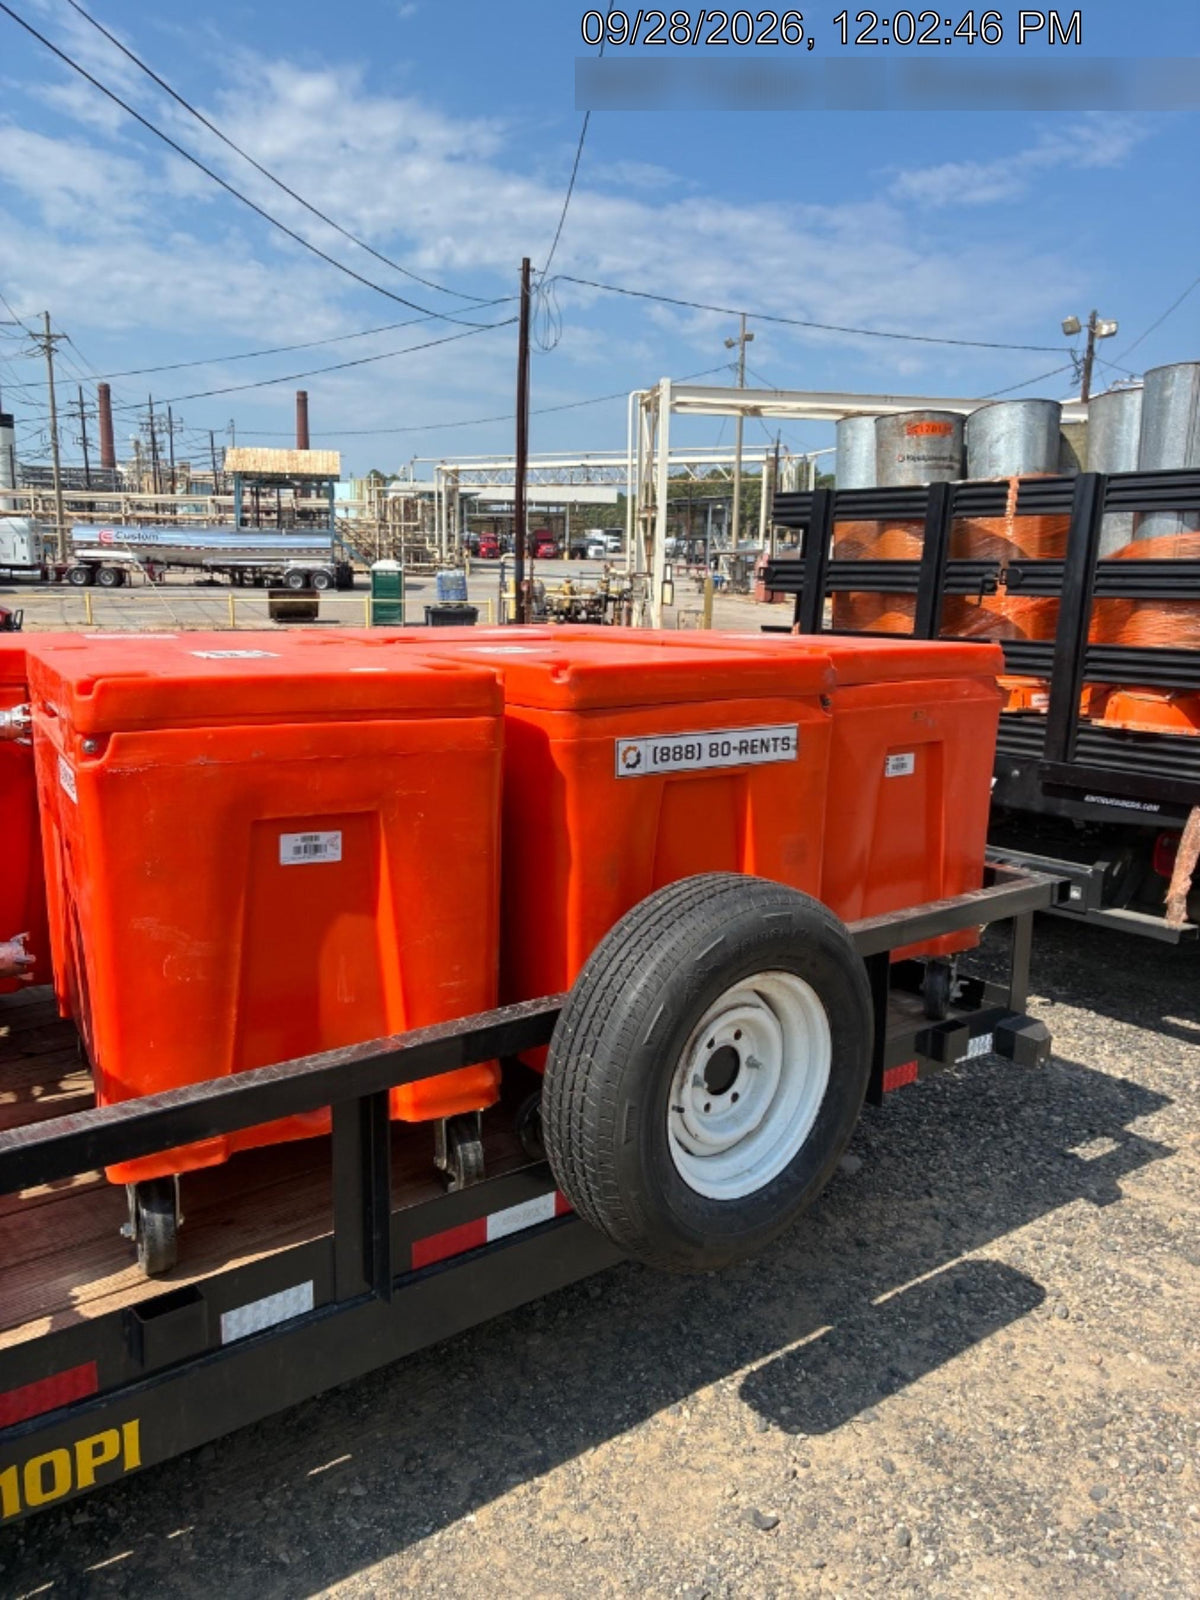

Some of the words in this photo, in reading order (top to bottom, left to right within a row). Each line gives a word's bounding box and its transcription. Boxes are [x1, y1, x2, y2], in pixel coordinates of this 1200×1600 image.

[115, 530, 159, 541] Custom
[652, 742, 702, 765] (888)
[708, 736, 791, 758] 80-RENTS
